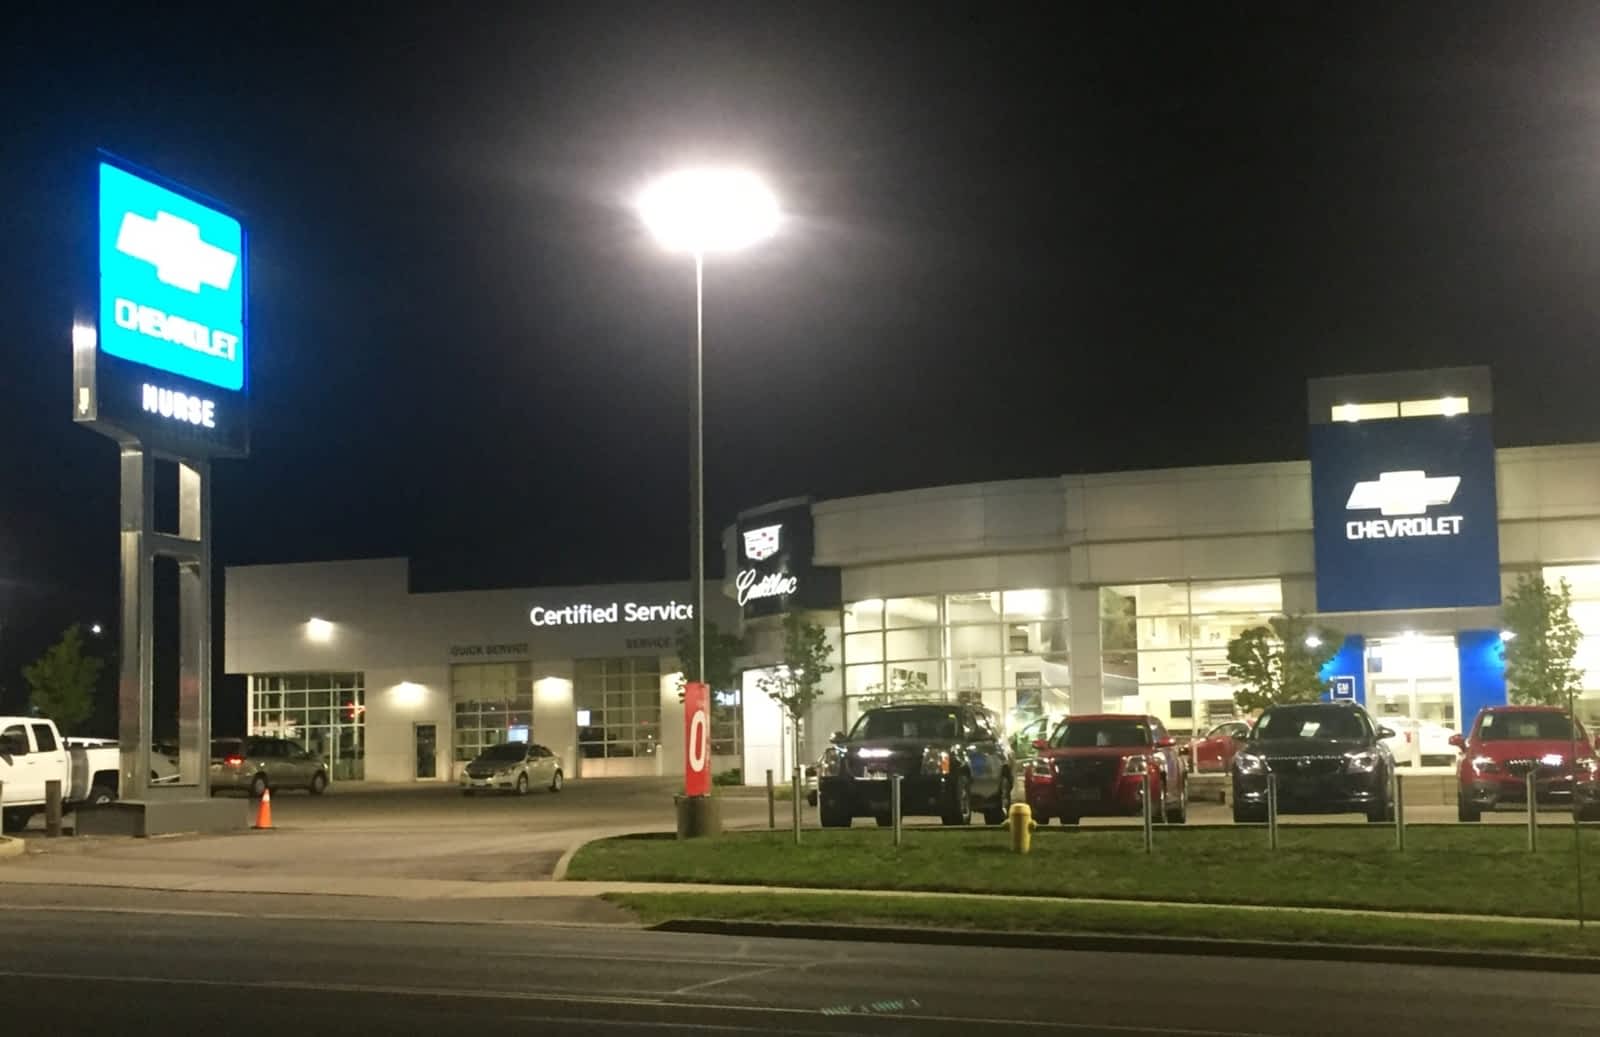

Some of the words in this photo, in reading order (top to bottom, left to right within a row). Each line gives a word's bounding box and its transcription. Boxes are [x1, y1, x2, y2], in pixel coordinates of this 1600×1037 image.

[114, 297, 239, 361] CHEVROLET
[142, 383, 216, 428] NURSE
[1346, 515, 1464, 540] CHEVROLET
[736, 568, 797, 606] Cadillac
[529, 602, 618, 626] Certified
